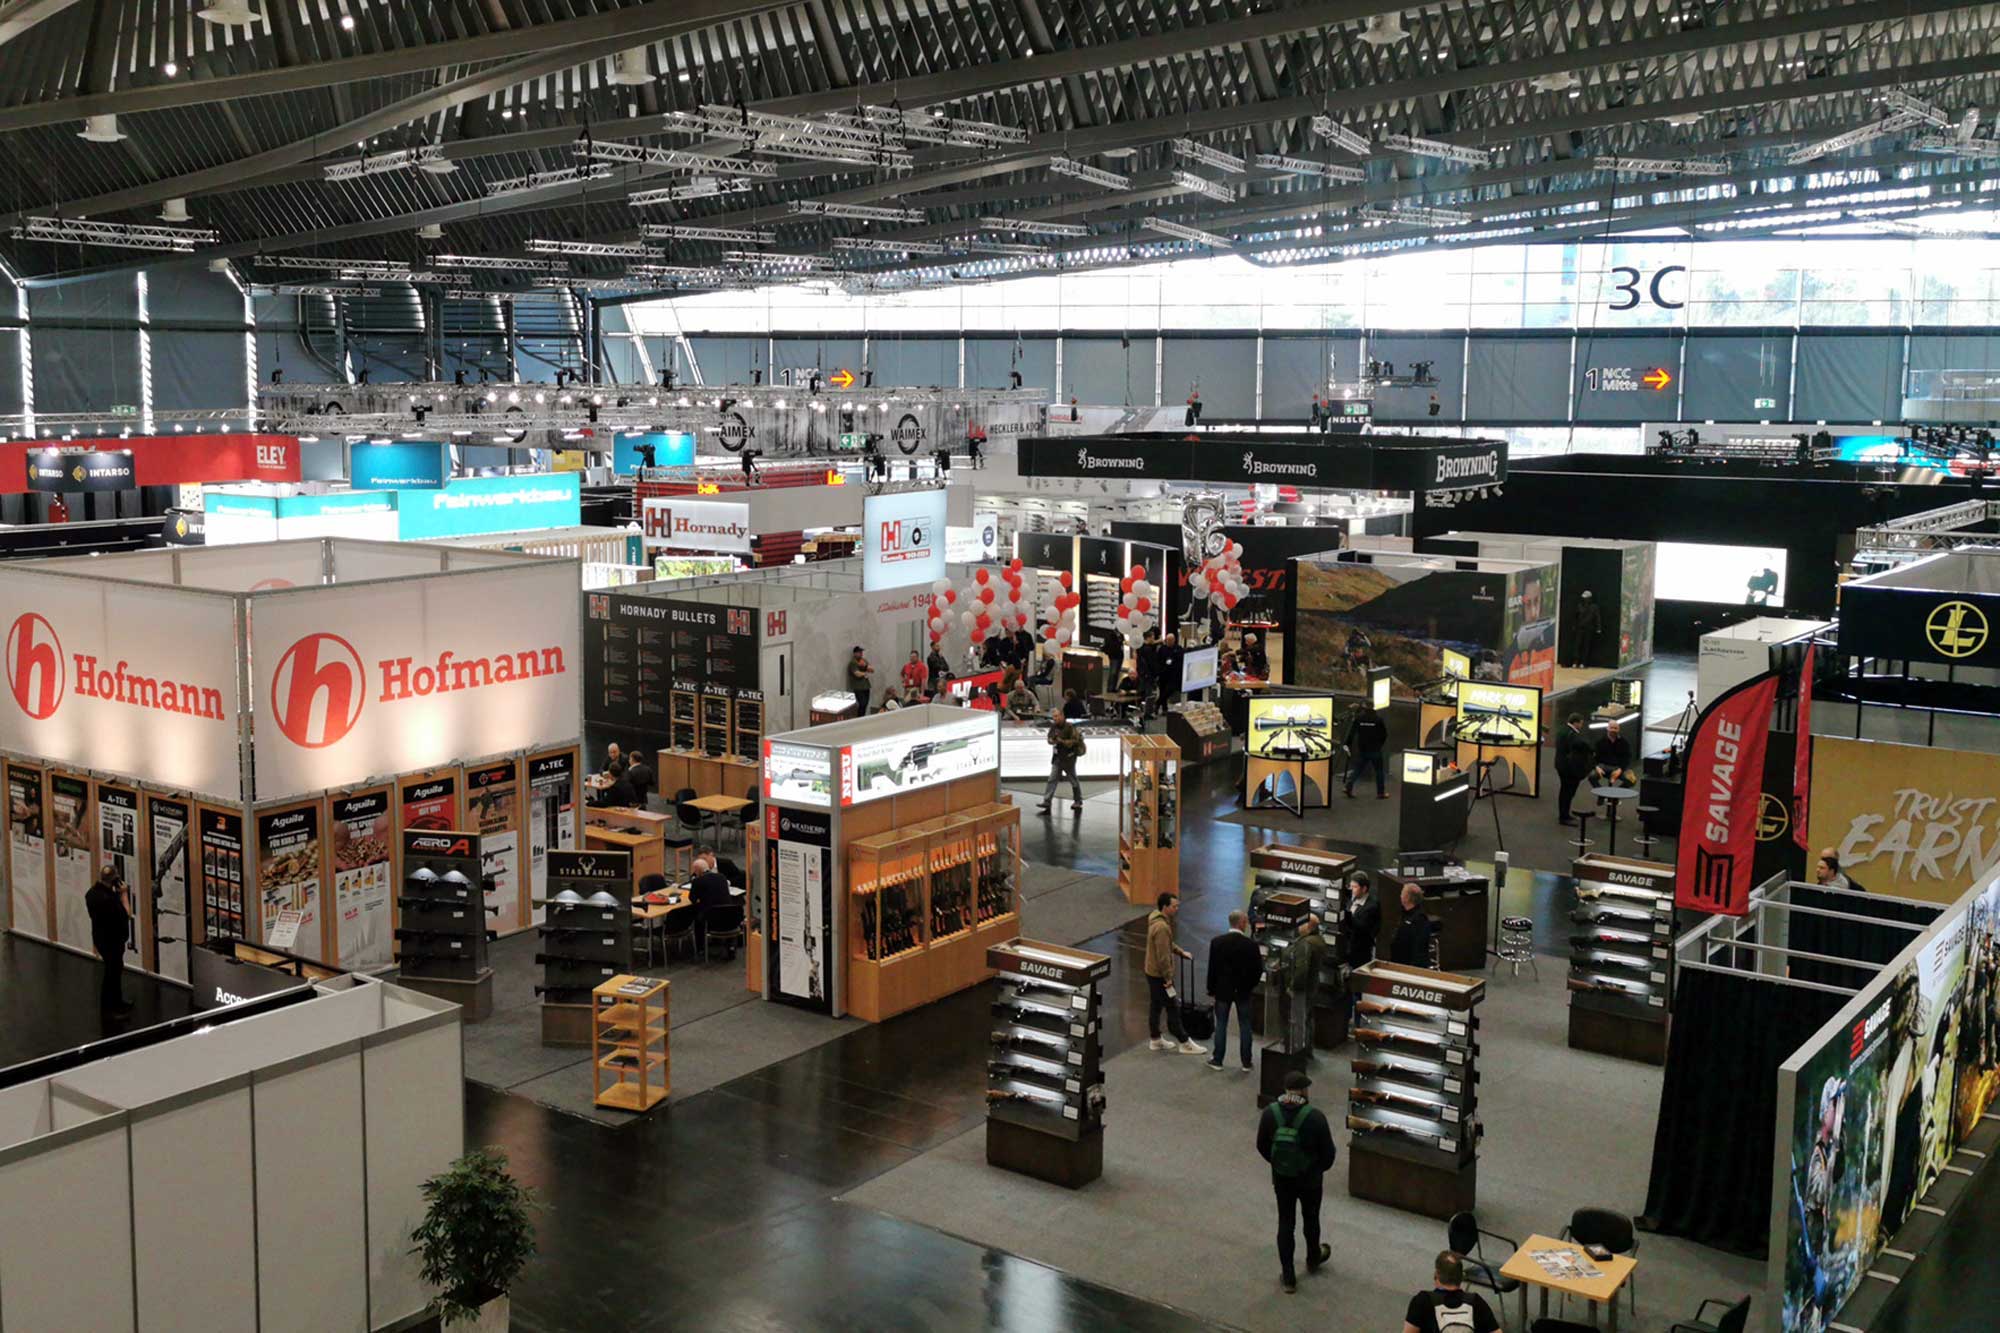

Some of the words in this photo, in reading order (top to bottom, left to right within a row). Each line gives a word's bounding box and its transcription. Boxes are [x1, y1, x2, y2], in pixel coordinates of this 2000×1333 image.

[1609, 265, 1685, 310] 3C
[1585, 367, 1598, 391] 1
[1602, 367, 1631, 379] NCC
[1601, 380, 1639, 391] Mitte
[890, 427, 927, 441] WAIMEX
[989, 422, 1018, 433] HECKLER
[256, 445, 286, 464] ELEY
[1087, 456, 1145, 471] BROWNING
[1253, 463, 1317, 477] BROWNING
[1435, 450, 1498, 483] BROWNING
[89, 467, 130, 478] INTARSO
[433, 488, 573, 511] Feinwerkbau
[674, 517, 748, 538] Hornady
[620, 604, 667, 619] HORNADY
[672, 610, 716, 625] BULLETS
[378, 645, 566, 703] Hofmann
[73, 653, 225, 721] Hofmann
[1705, 720, 1742, 844] SAVAGE
[413, 784, 444, 798] Aguila
[344, 798, 377, 812] Aguila
[1893, 787, 1997, 826] TRUST
[271, 814, 304, 828] Aguila
[592, 868, 615, 877] ARMS
[1281, 860, 1321, 875] SAVAGE
[1608, 871, 1653, 887] SAVAGE
[1267, 914, 1292, 923] SAVAGE
[1020, 961, 1063, 979] SAVAGE
[1392, 984, 1443, 1003] SAVAGE
